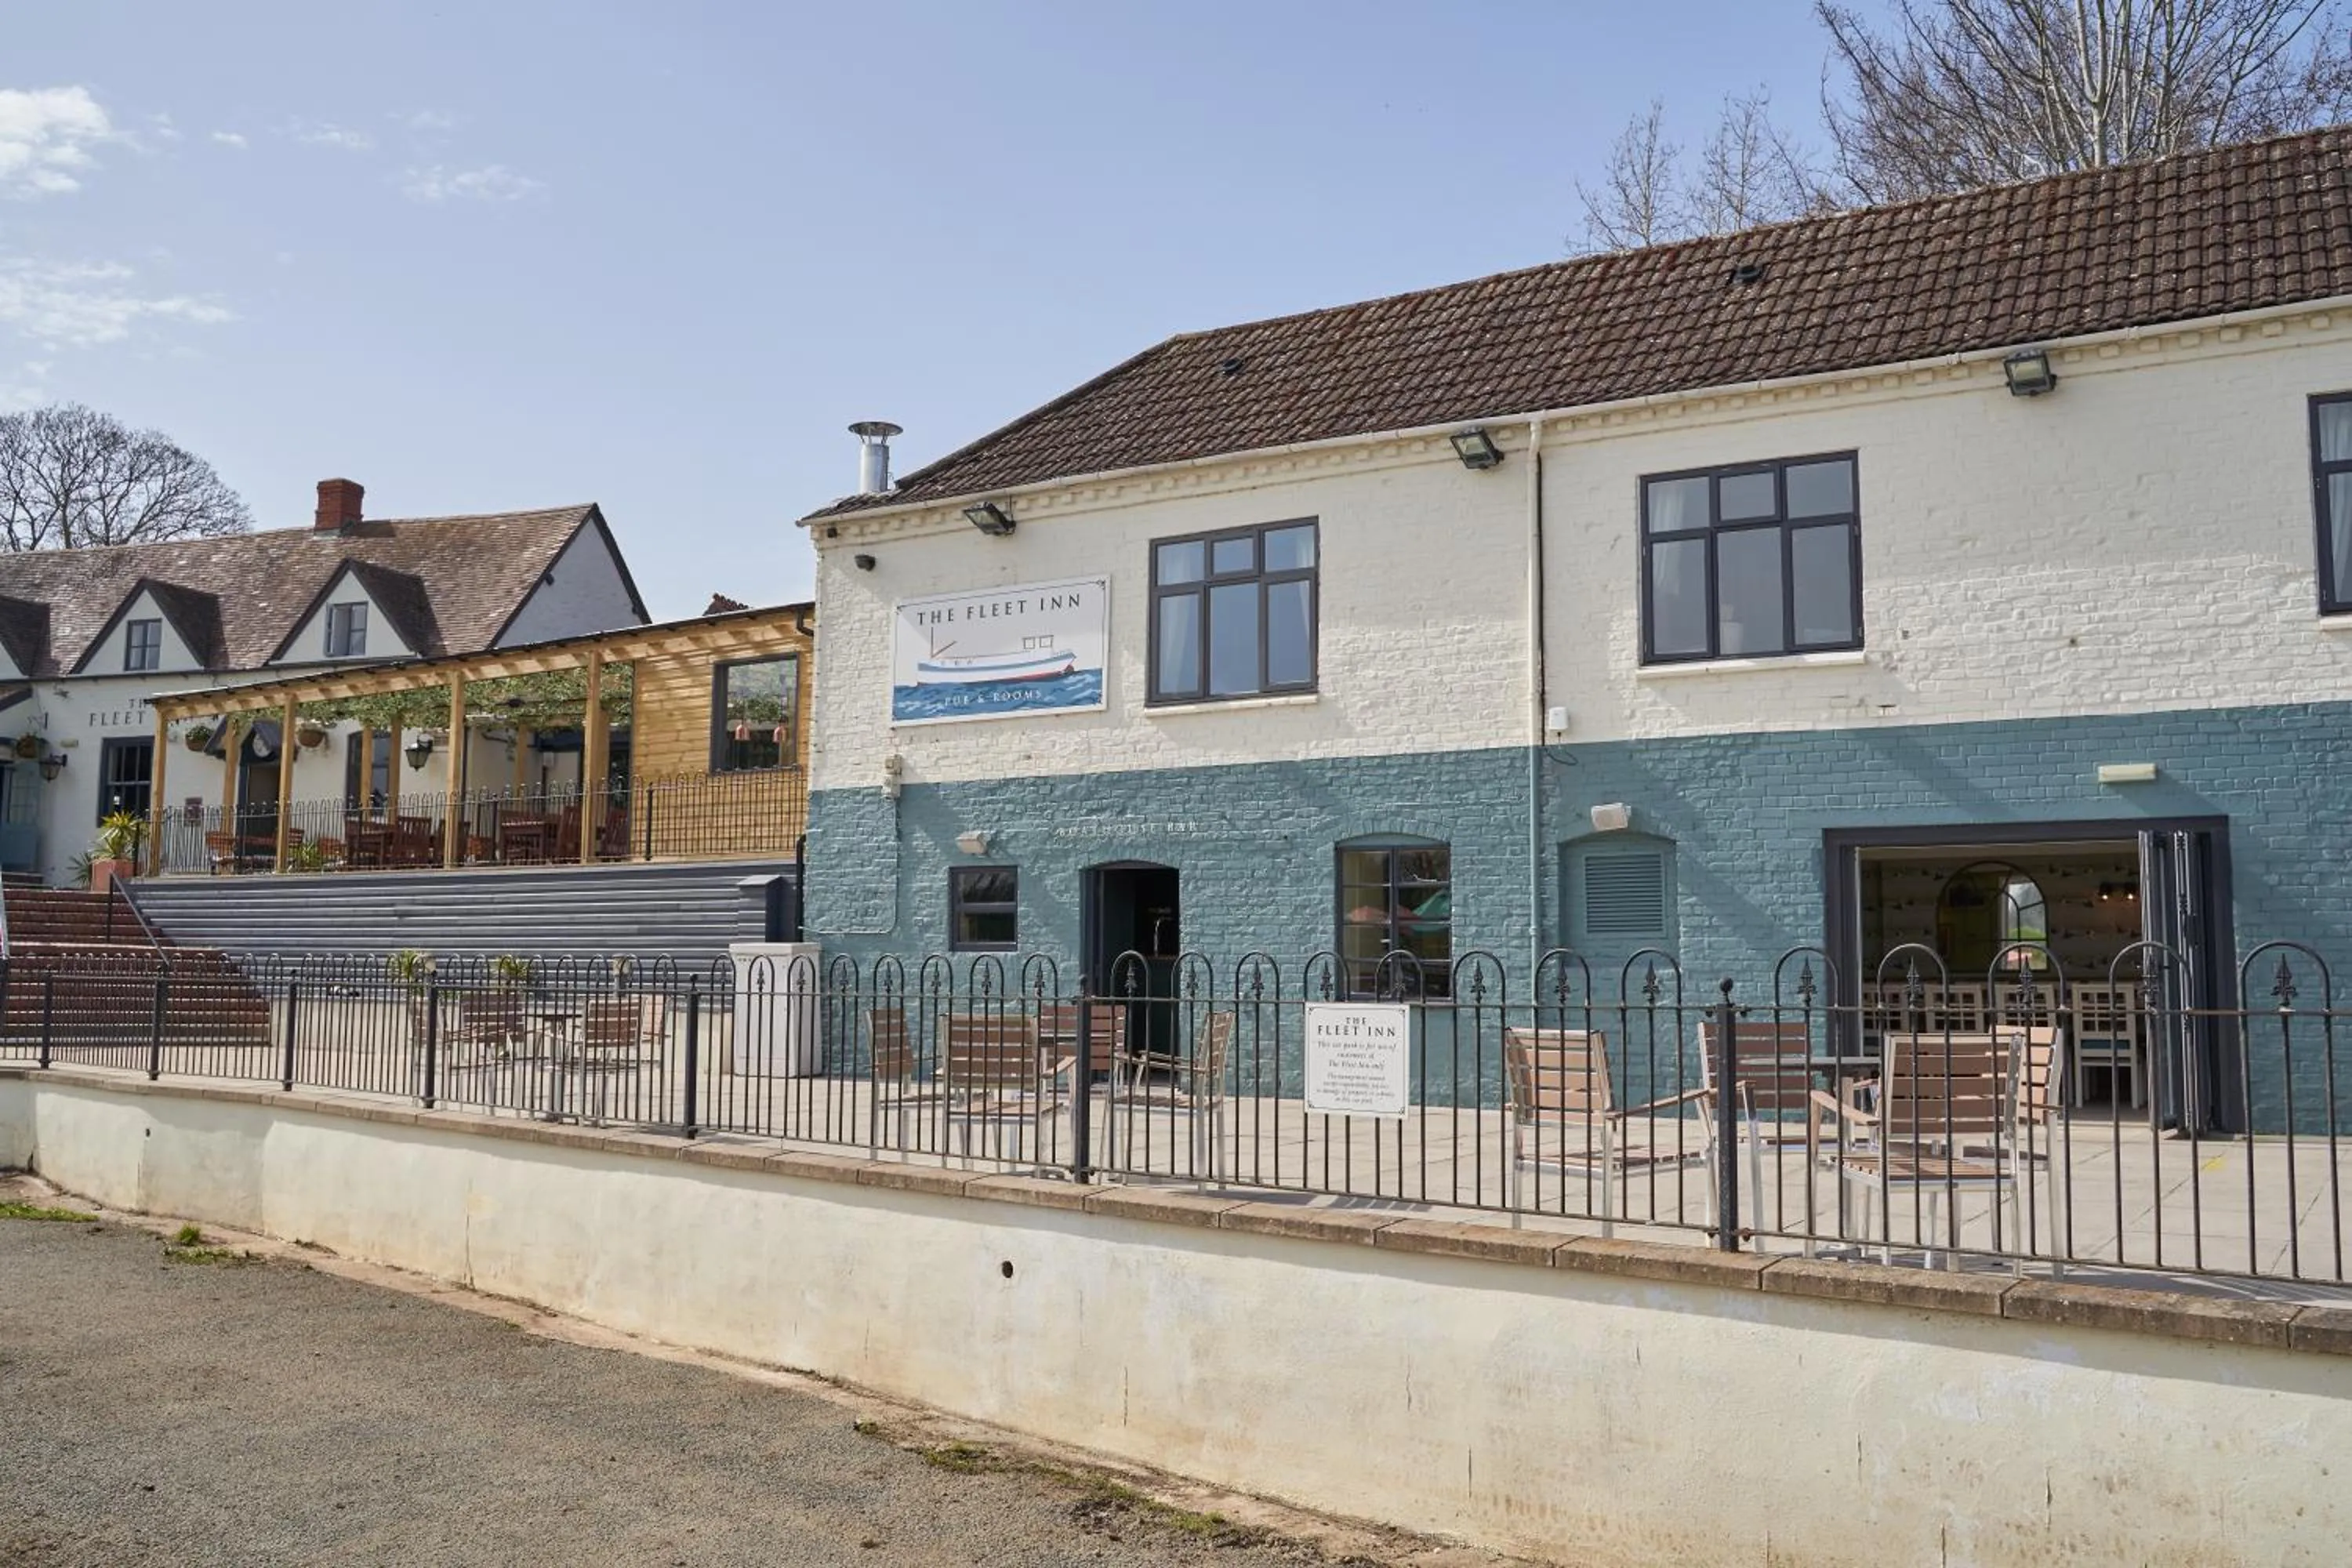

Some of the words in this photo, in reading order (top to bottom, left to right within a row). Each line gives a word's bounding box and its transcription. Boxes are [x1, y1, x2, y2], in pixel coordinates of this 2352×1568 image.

[917, 608, 954, 626] THE
[967, 600, 1027, 620] FLEET
[1040, 593, 1080, 612] INN
[993, 689, 1042, 703] ROOMS
[89, 711, 147, 727] FLEET
[1345, 1017, 1367, 1025] THE
[1317, 1025, 1359, 1036] FLEET
[1368, 1026, 1396, 1037] INN
